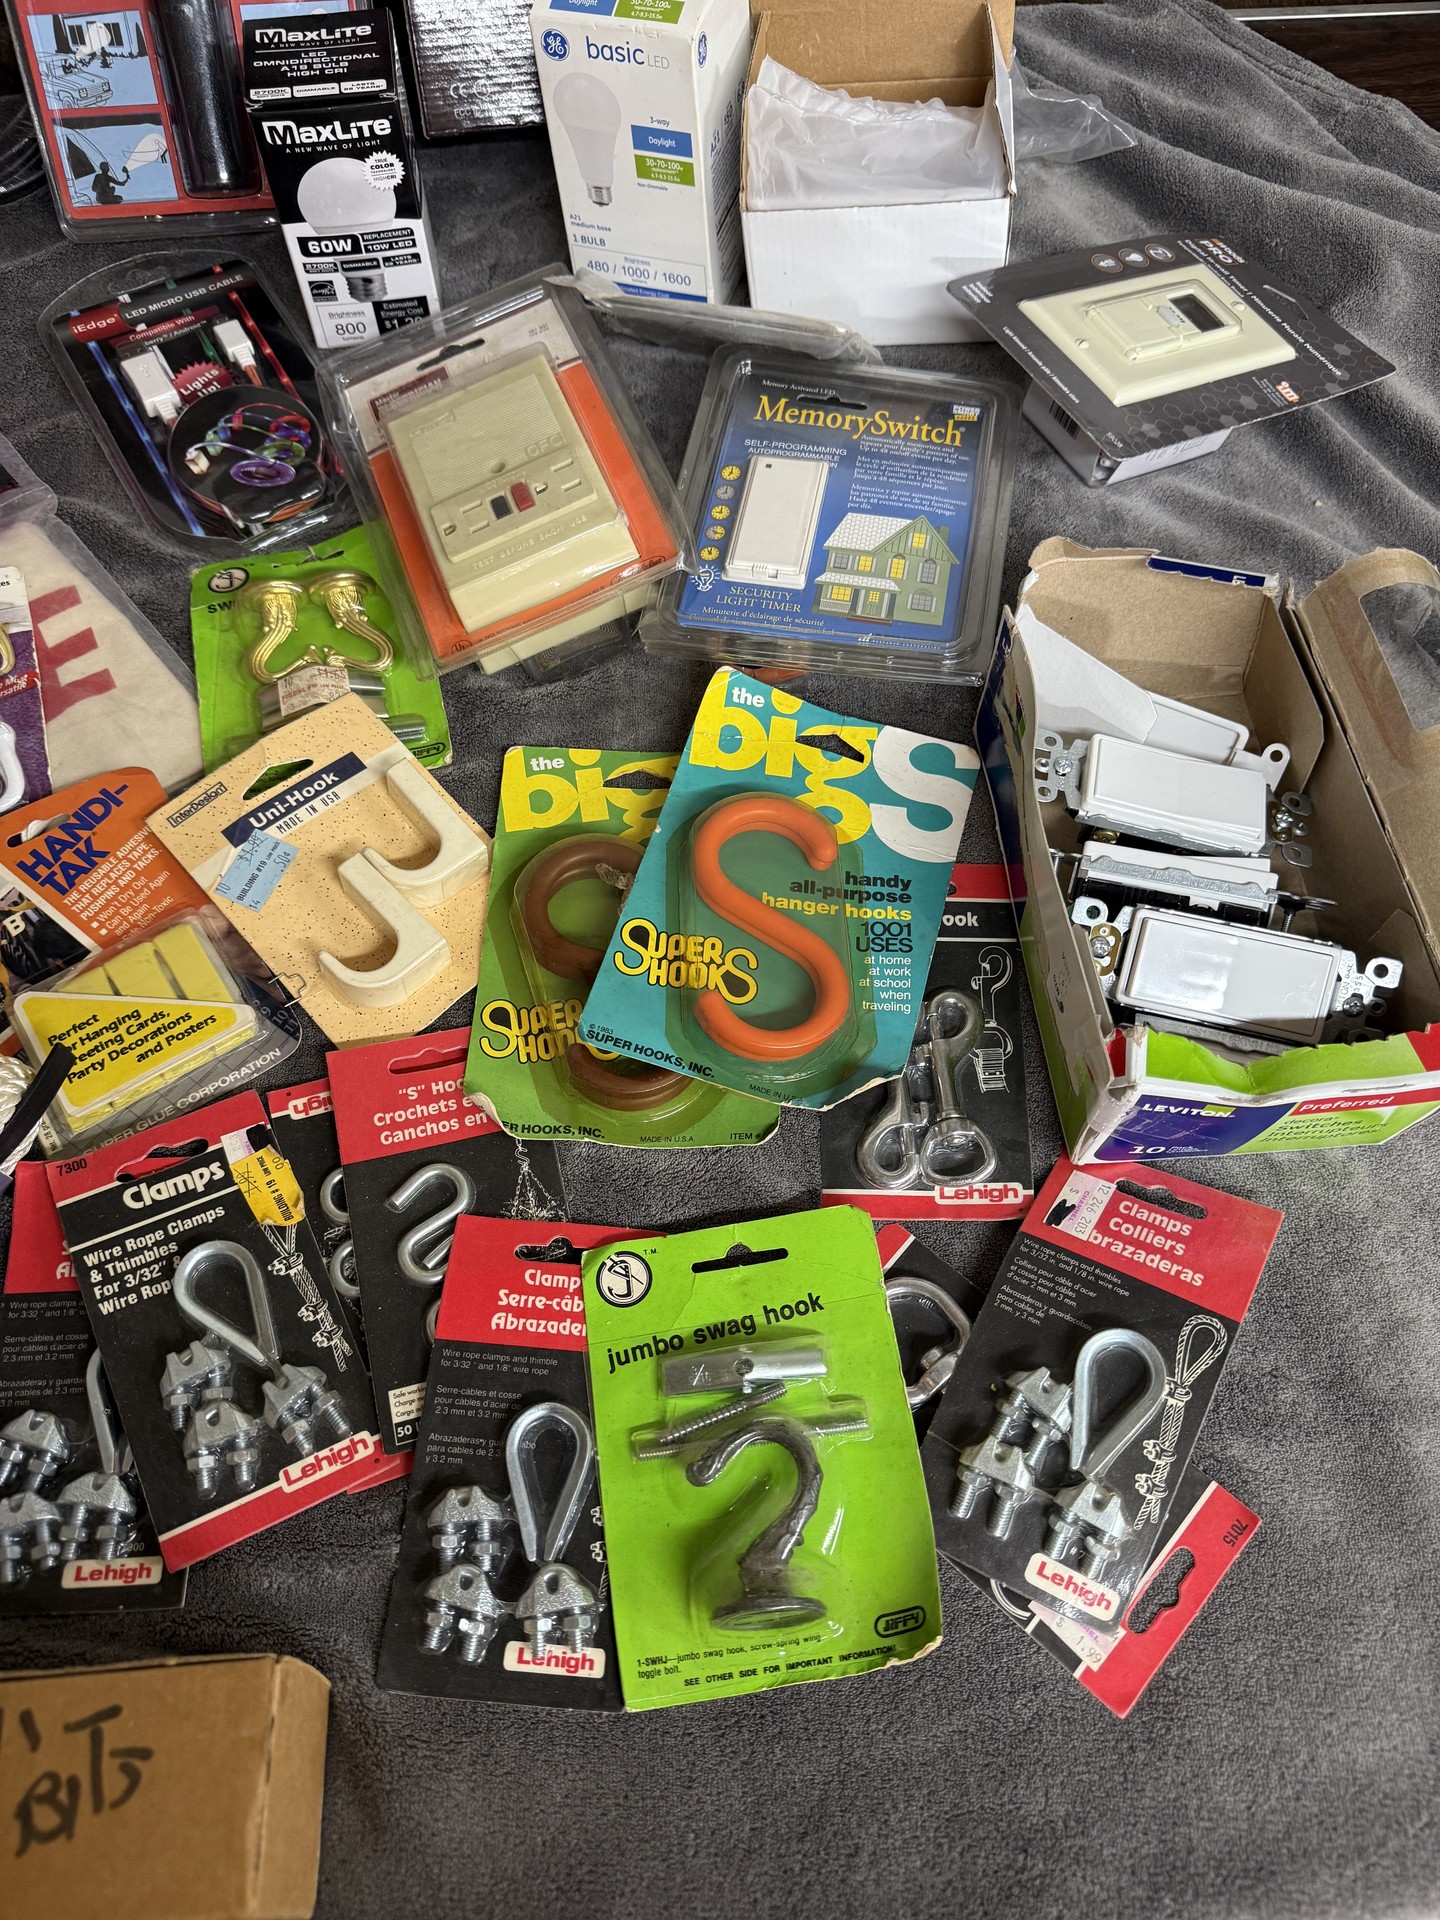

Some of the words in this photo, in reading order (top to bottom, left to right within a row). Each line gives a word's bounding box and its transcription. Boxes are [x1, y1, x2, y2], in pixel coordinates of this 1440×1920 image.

[253, 53, 380, 67] OMNIDIRECTIONAL
[586, 36, 645, 65] basic
[648, 56, 669, 69] LED
[287, 69, 320, 77] HIGH
[650, 117, 670, 127] 3-way
[357, 139, 380, 148] LIGHT
[648, 136, 676, 148] Daylight
[308, 238, 351, 254] 60W
[364, 229, 411, 240] REPLACEMENT
[367, 241, 390, 251] 10W
[393, 240, 413, 248] LED
[573, 234, 578, 242] 1
[581, 235, 606, 247] BULB
[1200, 240, 1234, 263] PRO
[587, 260, 609, 273] 480
[622, 266, 650, 280] 1000
[662, 272, 691, 286] 1600
[125, 307, 147, 319] LED
[149, 295, 183, 311] MICRO
[185, 289, 207, 301] USB
[208, 274, 244, 292] CABLE
[72, 316, 115, 333] iEdge
[129, 323, 176, 342] Compatible
[176, 315, 195, 327] With
[335, 322, 366, 336] 800
[1229, 273, 1248, 292] Timer
[1251, 295, 1282, 323] Minuterie
[1282, 322, 1304, 343] Murale
[1304, 343, 1342, 376] Numérique
[179, 367, 220, 396] Lights
[754, 395, 962, 447] MemorySwitch
[744, 439, 847, 456] SELF-PROGRAMMING
[748, 448, 840, 462] AUTOPROGRAMMABLE
[716, 595, 758, 607] LIGHT
[760, 599, 801, 613] TIMER
[730, 586, 793, 600] SECURITY
[702, 607, 740, 616] Minuterie
[795, 617, 825, 626] sécurité
[731, 686, 766, 709] the
[530, 756, 565, 773] the
[171, 784, 226, 824] InterDesign
[249, 772, 340, 828] Uni-Hook
[870, 724, 981, 864] S
[276, 813, 304, 834] MADE
[305, 805, 319, 816] IN
[321, 790, 341, 807] USA
[16, 784, 129, 882] HANDI-
[39, 835, 111, 896] TAK
[63, 889, 82, 907] THE
[80, 855, 118, 892] REUSABLE
[71, 896, 94, 913] THAT
[92, 861, 131, 899] REPLACES
[79, 886, 120, 921] PUSHPINS
[119, 869, 136, 887] AND
[134, 848, 162, 872] TACKS.
[236, 873, 259, 901] BUILDING
[789, 880, 912, 904] all-purpose
[844, 871, 912, 891] handy
[97, 899, 122, 922] Won't
[119, 888, 135, 902] Dry
[136, 876, 149, 891] Out
[105, 914, 123, 930] Can
[121, 904, 133, 916] Be
[132, 889, 151, 907] Used
[149, 870, 171, 891] Again
[762, 892, 839, 915] hanger
[845, 903, 912, 921] hooks
[115, 922, 130, 937] and
[129, 903, 150, 926] Again
[860, 921, 911, 937] 1001
[942, 912, 979, 927] ook
[614, 918, 724, 976] SUPER
[856, 937, 913, 953] USES
[864, 956, 875, 965] at
[879, 955, 911, 965] home
[869, 967, 880, 976] at
[884, 966, 911, 976] work
[649, 946, 759, 1005] HOOKS
[859, 978, 870, 987] at
[874, 978, 911, 988] school
[861, 1000, 911, 1014] traveling
[880, 990, 911, 1000] when
[47, 1014, 100, 1047] Perfect
[72, 1035, 125, 1066] reeting
[125, 1010, 171, 1036] Cards,
[79, 1009, 142, 1047] Hanging
[136, 1046, 166, 1063] and
[168, 1014, 217, 1045] Posters
[597, 1025, 614, 1035] 1983
[67, 1059, 105, 1084] Party
[109, 1012, 192, 1062] Decorations
[586, 1029, 633, 1052] SUPER
[634, 1046, 687, 1071] HOOKS,
[688, 1061, 715, 1079] INC.
[136, 1106, 175, 1132] GLUE
[176, 1047, 282, 1110] CORPORATION
[431, 1079, 464, 1095] Hoo
[374, 1098, 457, 1127] Crochets
[1142, 1103, 1230, 1118] LEVITON
[1298, 1096, 1396, 1112] Preferred
[380, 1118, 460, 1145] Ganchos
[465, 1112, 488, 1127] en
[640, 1135, 662, 1143] MADE
[1128, 1146, 1167, 1154] 10
[56, 1158, 87, 1176] 7300
[122, 1161, 226, 1210] Clamps
[939, 1184, 1018, 1202] Lehigh
[1119, 1200, 1192, 1236] Clamps
[83, 1246, 123, 1269] Wire
[125, 1230, 165, 1252] Rope
[167, 1205, 226, 1235] Clamps
[1109, 1217, 1186, 1256] Colliers
[89, 1269, 103, 1284] &
[105, 1241, 179, 1281] Thimbles
[1024, 1237, 1039, 1249] Wire
[1041, 1245, 1056, 1256] rope
[1056, 1252, 1079, 1265] clamps
[1080, 1262, 1094, 1272] and
[1095, 1266, 1122, 1285] thimbles
[1089, 1229, 1205, 1287] brazaderas
[93, 1283, 120, 1300] For
[524, 1269, 582, 1292] Clamp
[98, 1292, 138, 1316] Wire
[141, 1278, 174, 1303] Rop
[498, 1289, 584, 1312] Serre-câb
[607, 1334, 685, 1374] jumbo
[693, 1314, 757, 1345] swag
[762, 1292, 824, 1326] hook
[442, 1348, 460, 1358] Wire
[482, 1352, 510, 1362] clamps
[530, 1356, 558, 1366] thimble
[498, 1392, 522, 1400] cosse
[282, 1435, 370, 1487] Lehigh
[1223, 1518, 1248, 1548] 7015
[74, 1563, 152, 1584] Lehigh
[1035, 1560, 1113, 1612] Lehigh
[882, 1612, 920, 1633] JIFFY
[517, 1647, 595, 1674] Lehigh
[638, 1669, 661, 1679] toggle
[664, 1665, 681, 1675] bolt.
[684, 1678, 700, 1687] SEE
[705, 1672, 734, 1683] OTHER
[739, 1668, 758, 1678] SIDE
[763, 1664, 780, 1674] FOR
[785, 1655, 833, 1671] IMPORTANT
[839, 1644, 897, 1663] INFORMATION!
